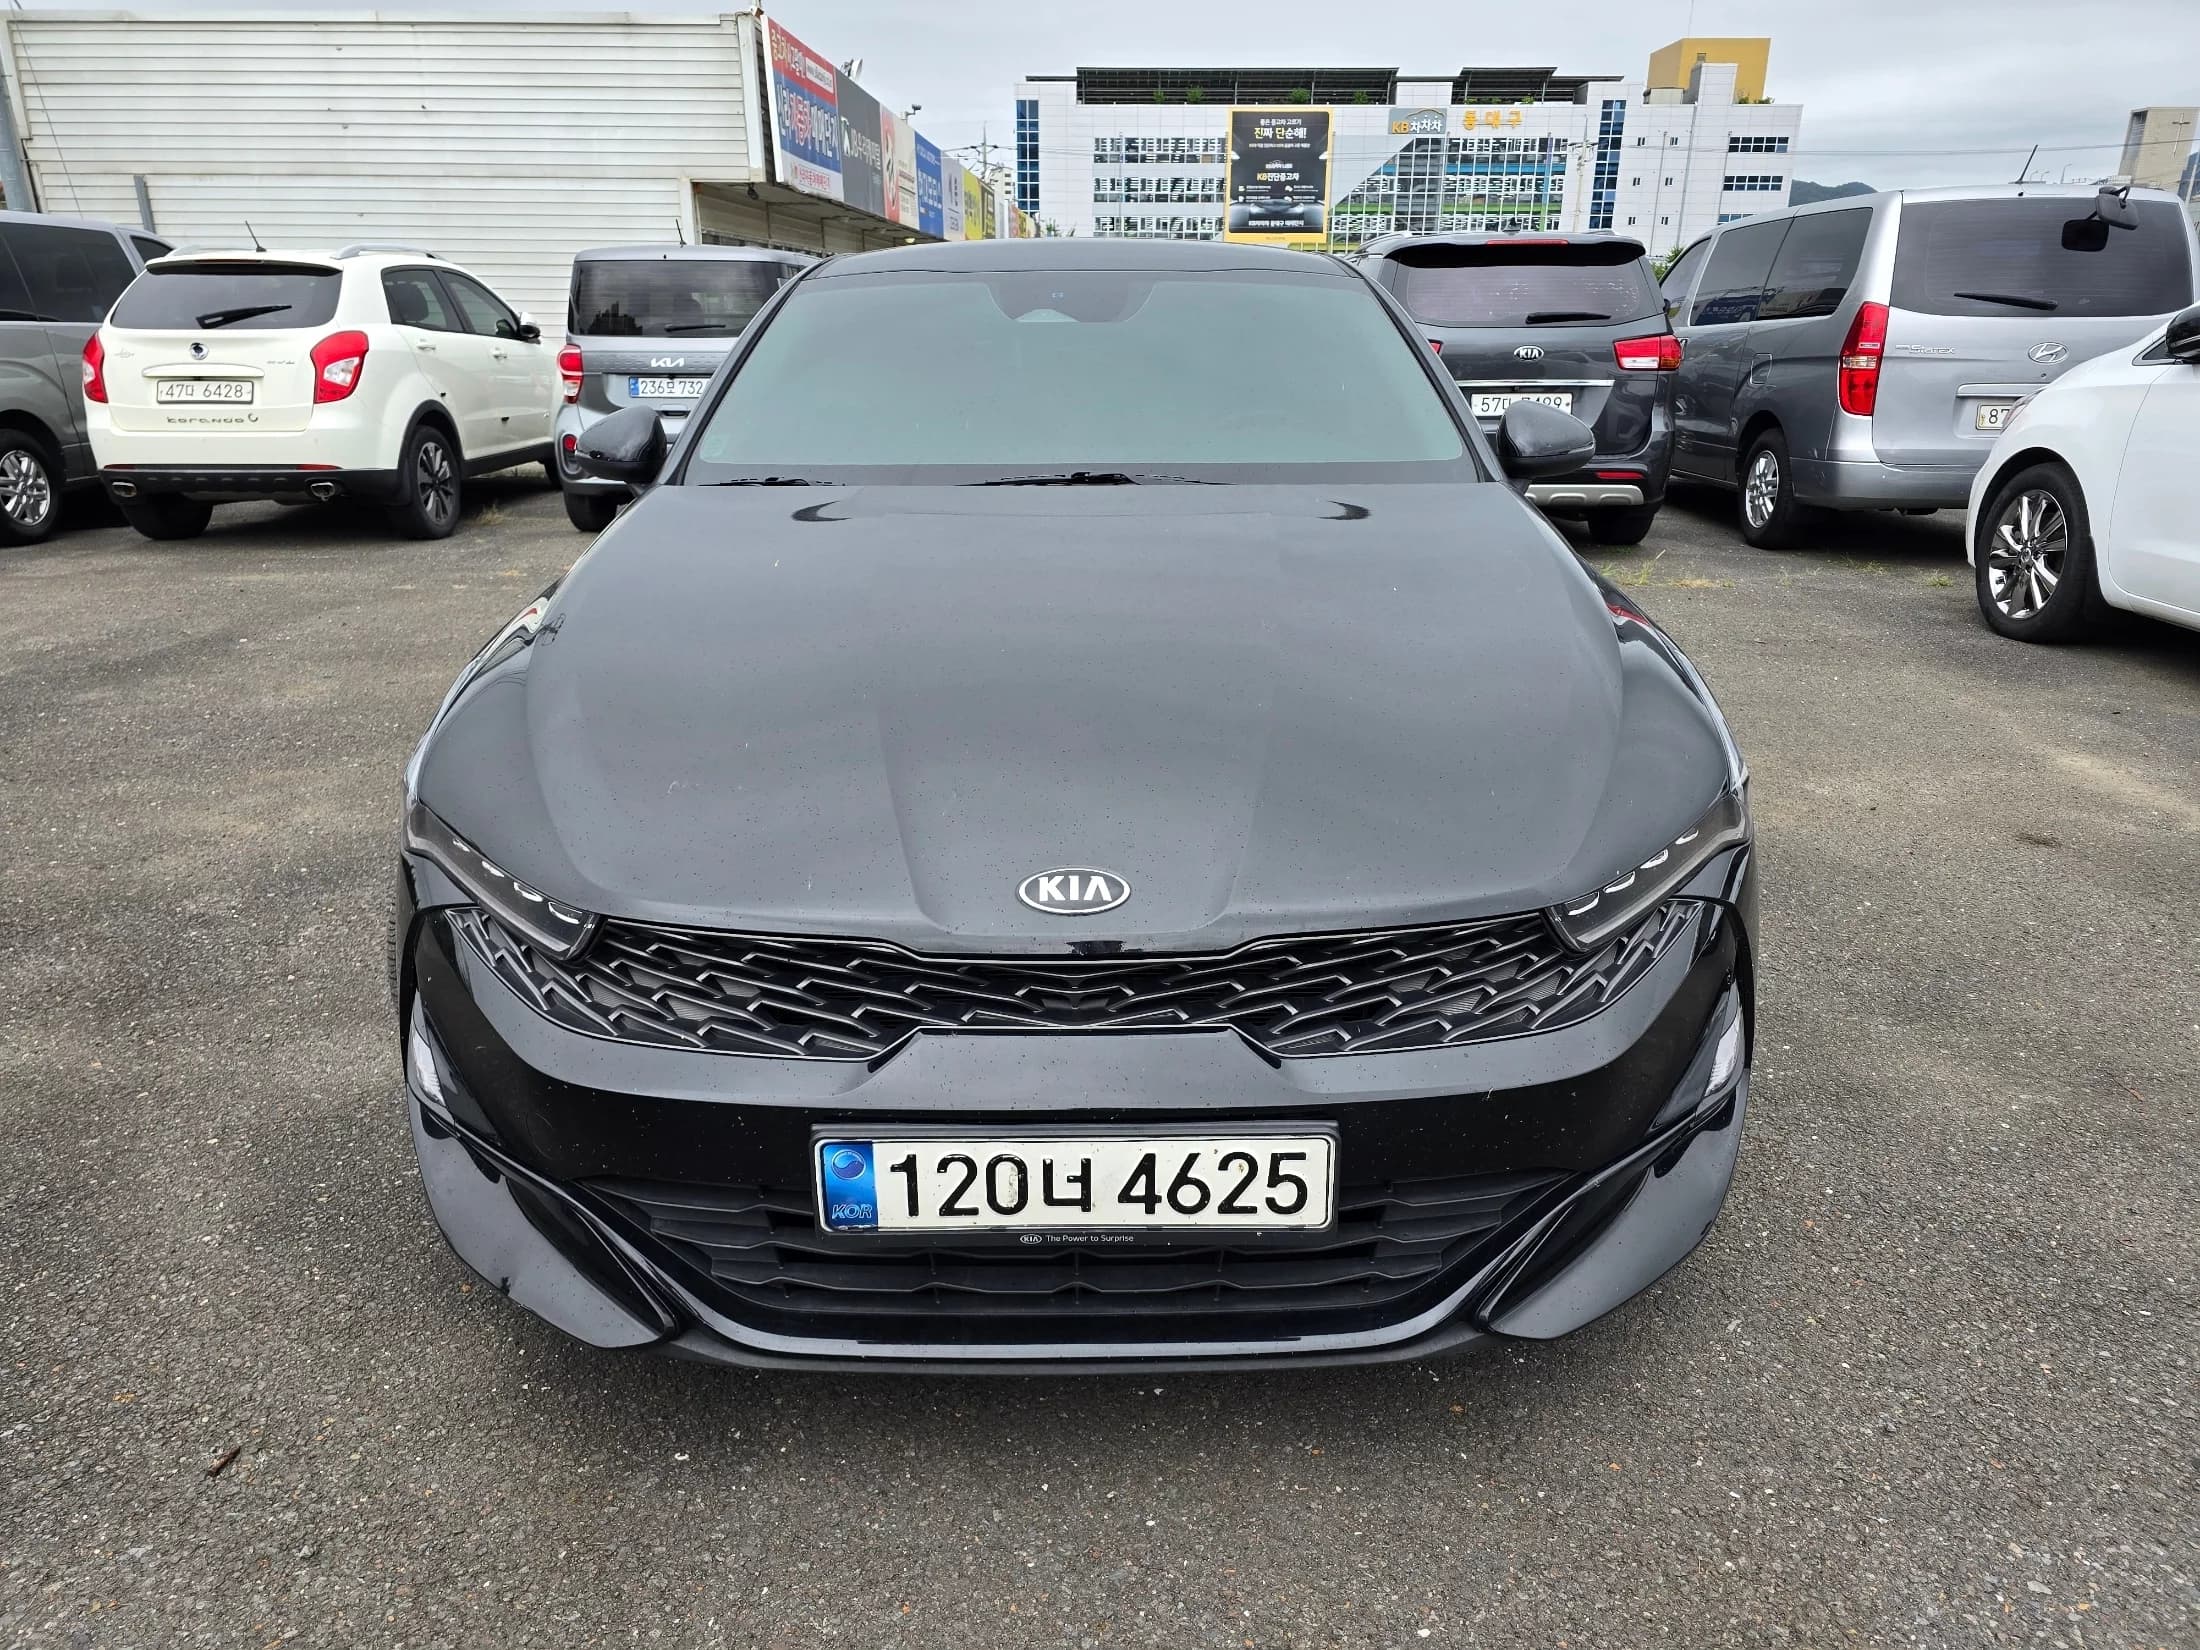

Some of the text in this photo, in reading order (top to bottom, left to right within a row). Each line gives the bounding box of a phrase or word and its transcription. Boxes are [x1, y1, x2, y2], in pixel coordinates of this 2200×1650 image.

[1392, 114, 1442, 134] KB차차차
[1254, 127, 1307, 139] 진짜 단순해!
[1256, 172, 1300, 182] KB진단중고차
[1518, 347, 1540, 360] KIA
[651, 357, 685, 368] KIA
[203, 383, 243, 398] 6428
[641, 380, 675, 395] 236모
[1037, 874, 1113, 902] KIA
[889, 1151, 1309, 1217] 120너 4625
[831, 1203, 873, 1220] KOR
[1022, 1235, 1041, 1243] KIA
[1101, 1234, 1134, 1243] Surprise
